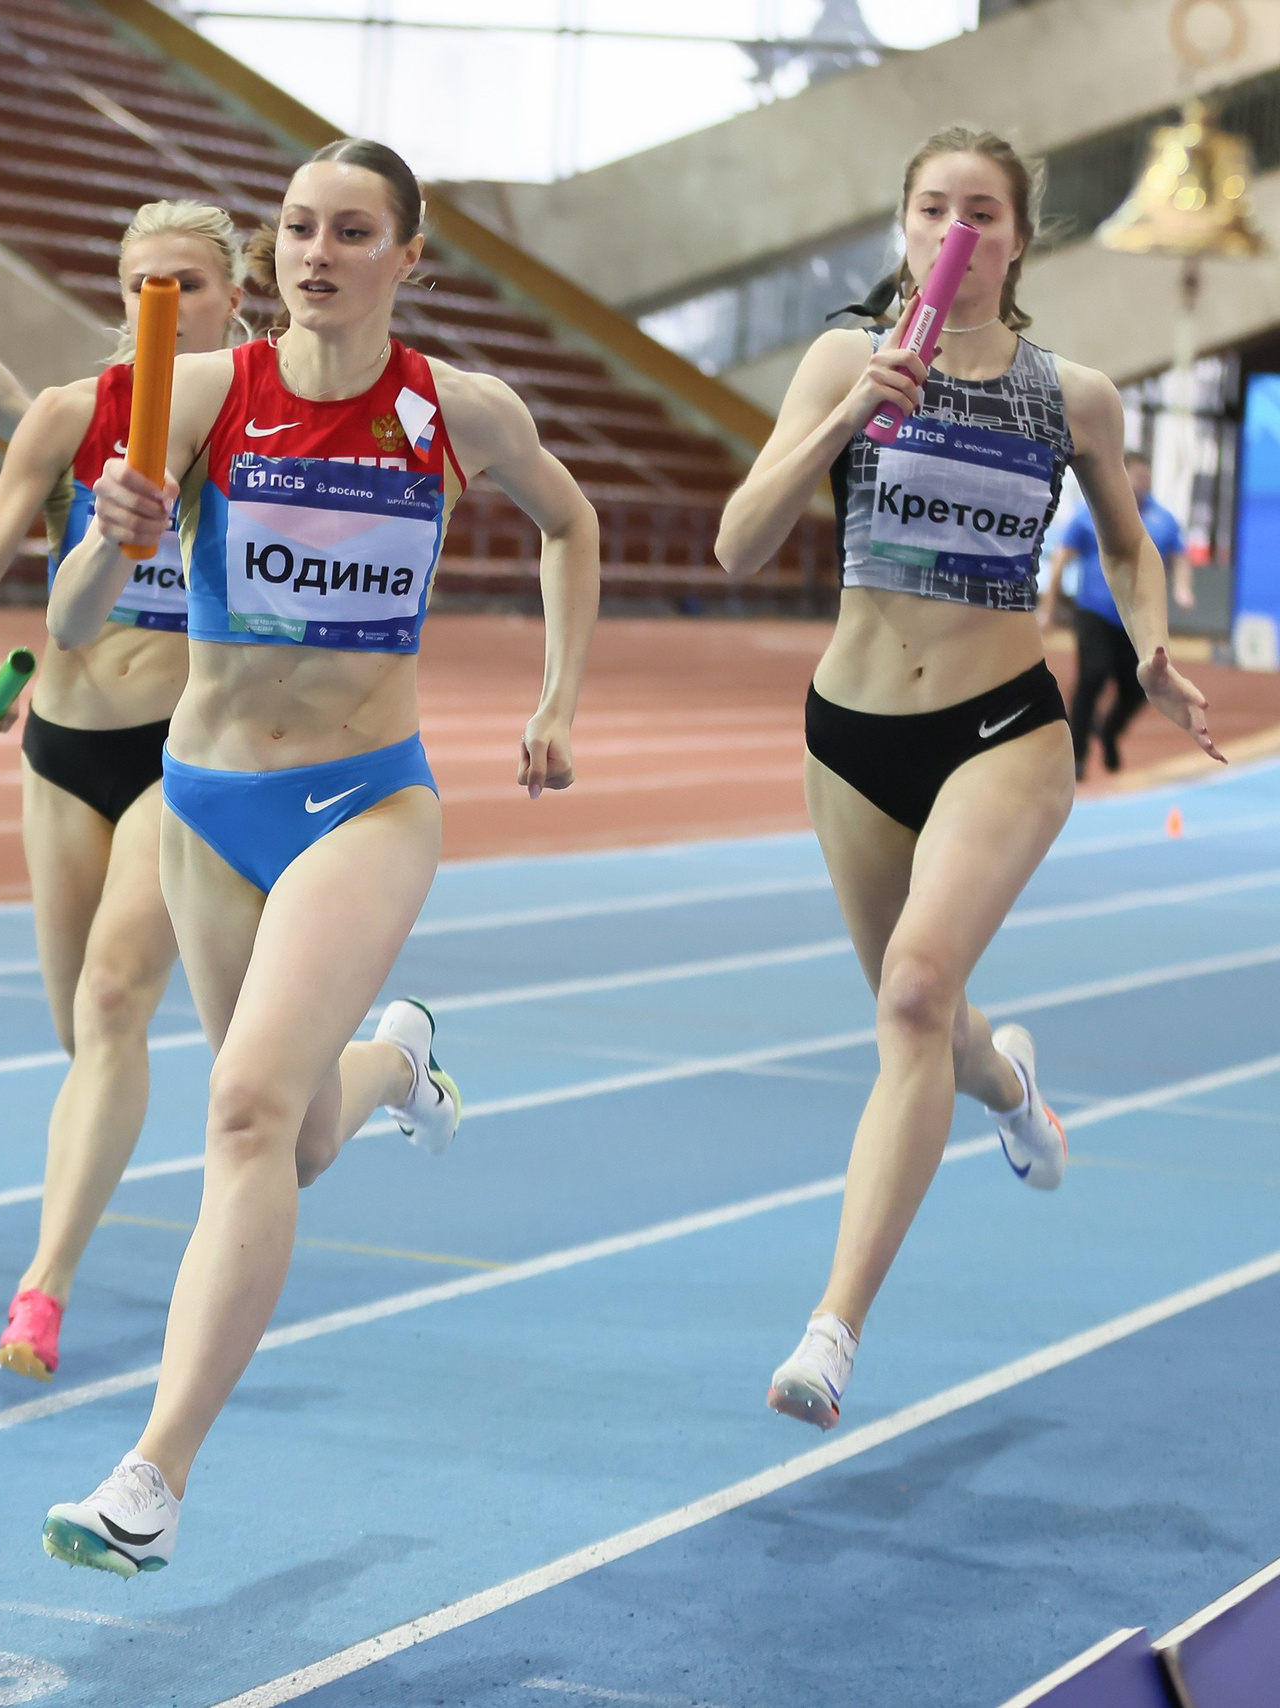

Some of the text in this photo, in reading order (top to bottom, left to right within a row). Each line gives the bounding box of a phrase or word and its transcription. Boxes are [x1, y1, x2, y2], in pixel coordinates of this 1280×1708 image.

[914, 310, 932, 347] polanik
[915, 429, 945, 444] ПСБ
[270, 473, 306, 490] ПСБ
[328, 487, 373, 499] ФОСАГРО
[877, 482, 1039, 539] Кретова
[245, 541, 414, 596] Юдина
